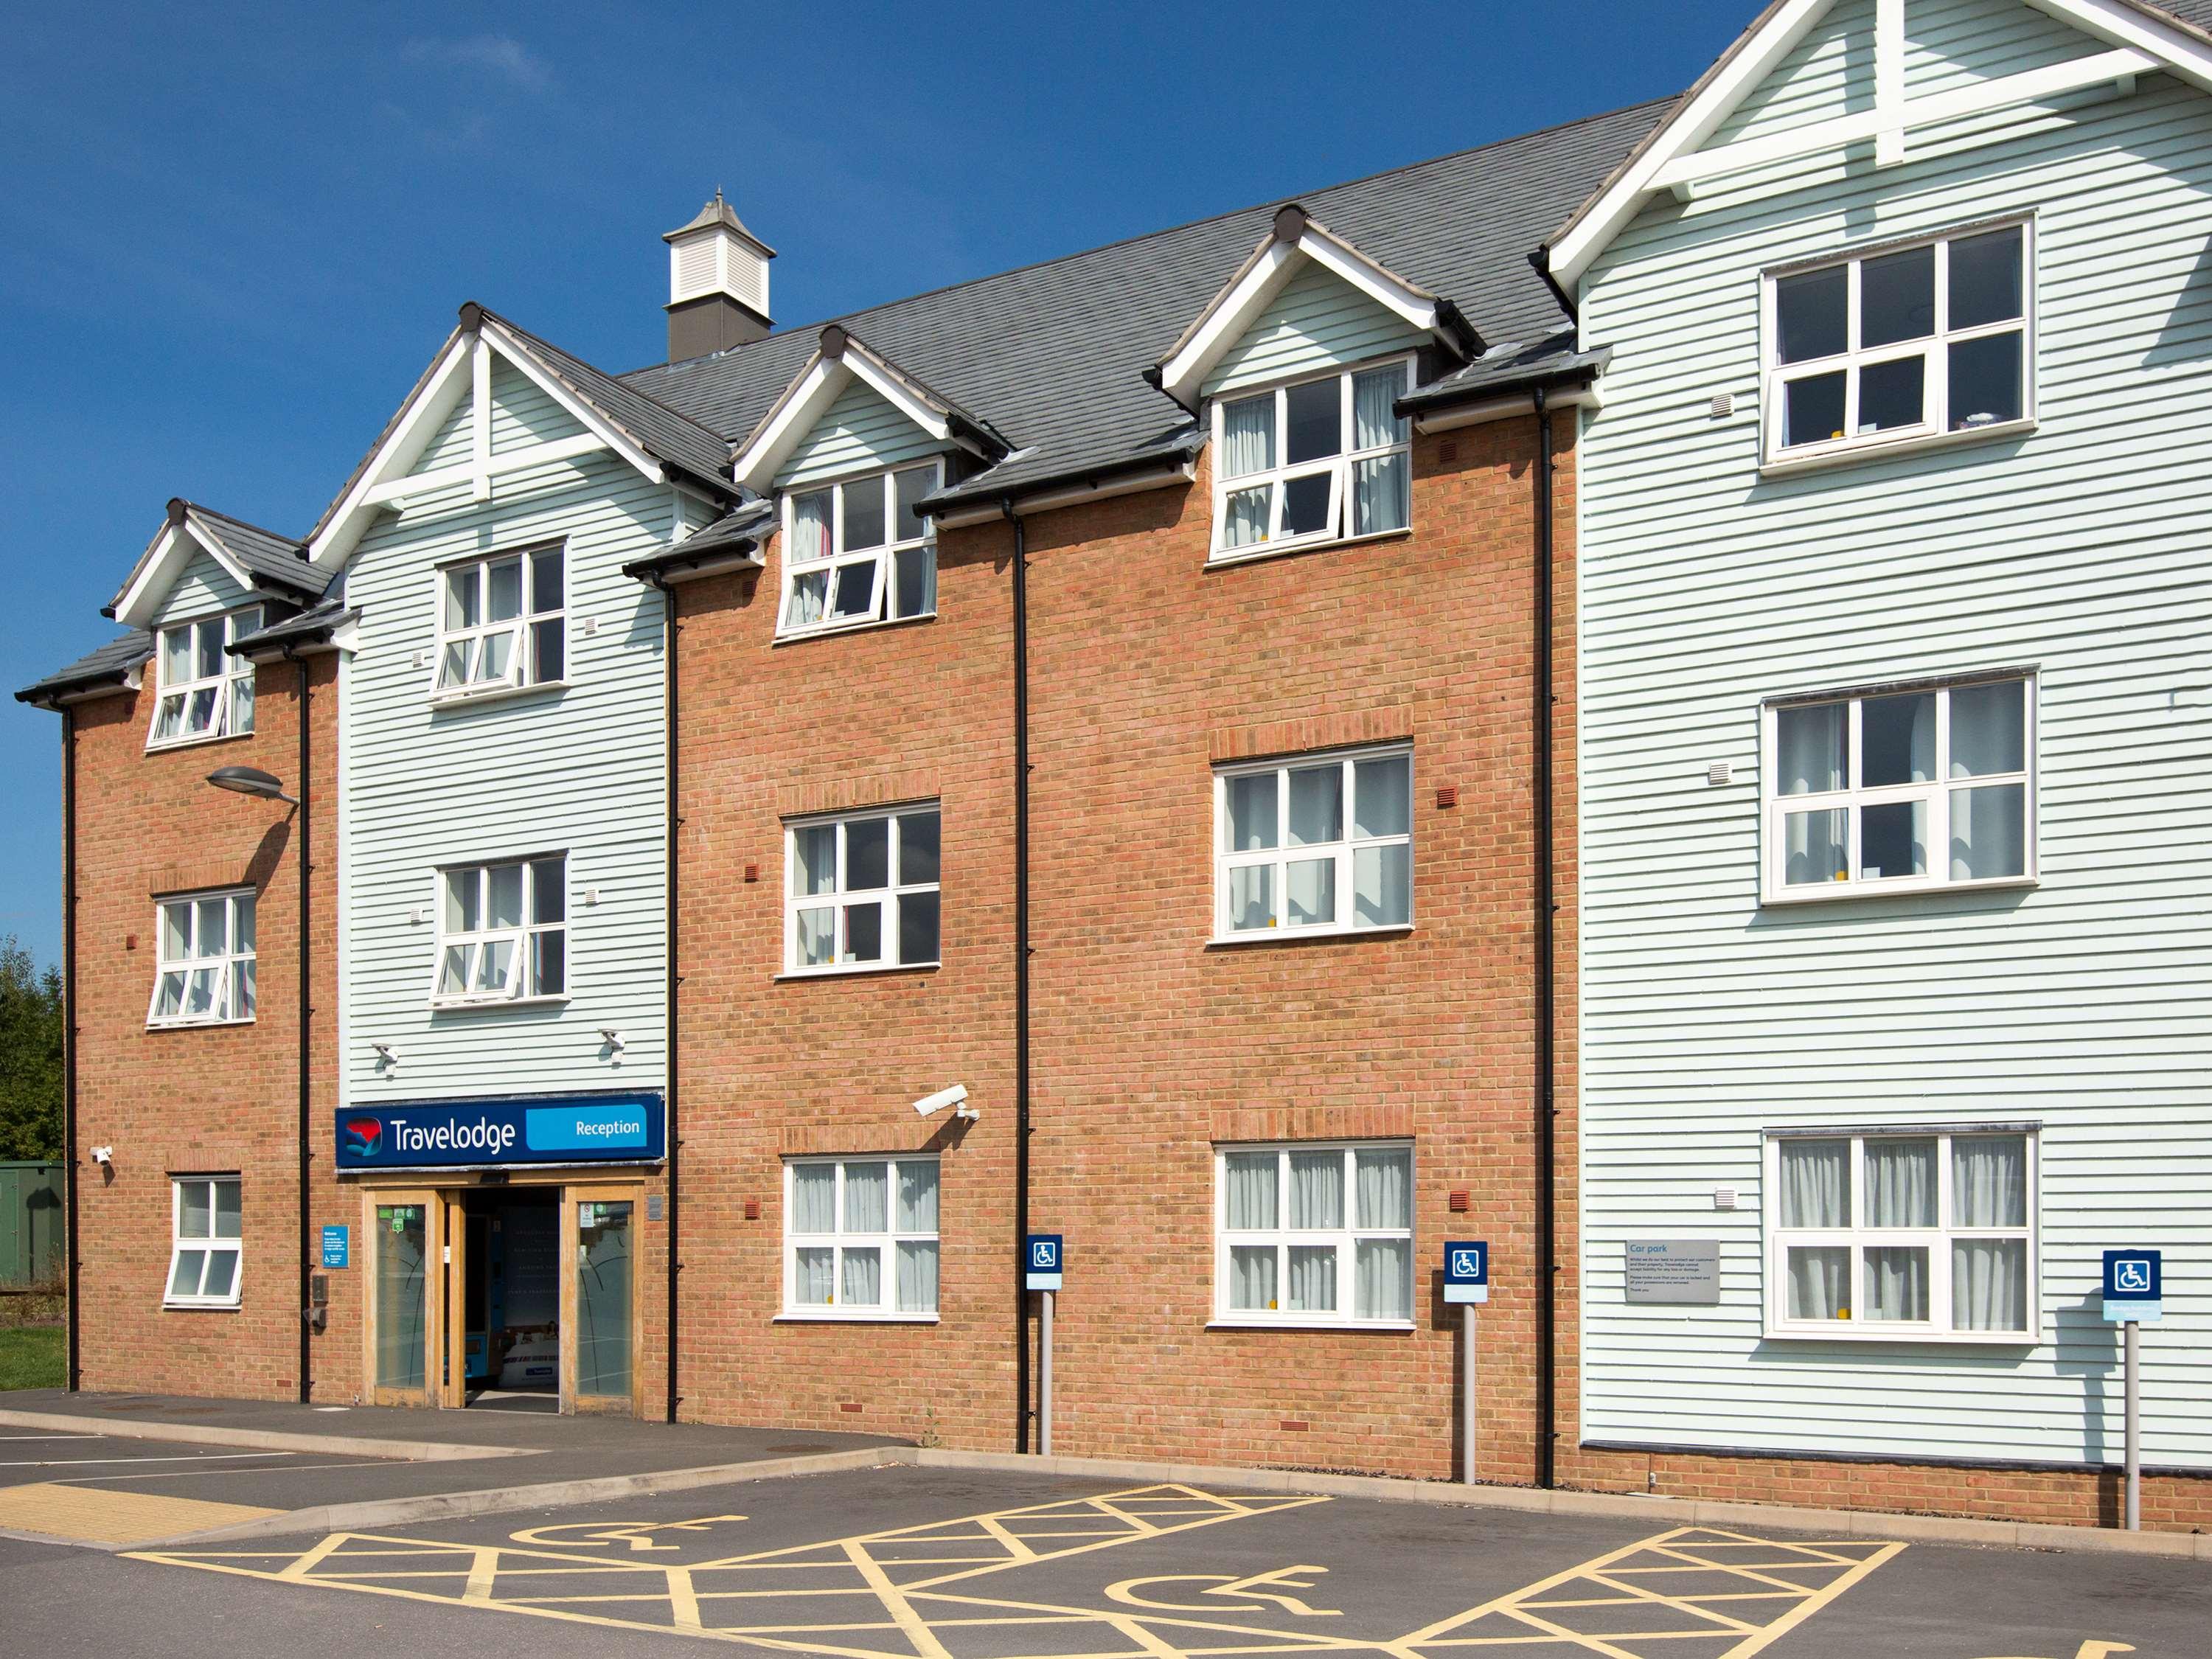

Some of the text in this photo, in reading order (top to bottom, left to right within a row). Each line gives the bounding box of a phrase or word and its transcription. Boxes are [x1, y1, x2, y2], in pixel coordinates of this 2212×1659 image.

[390, 1116, 515, 1155] Travelodge
[576, 1120, 639, 1138] Reception
[1647, 1245, 1668, 1253] park
